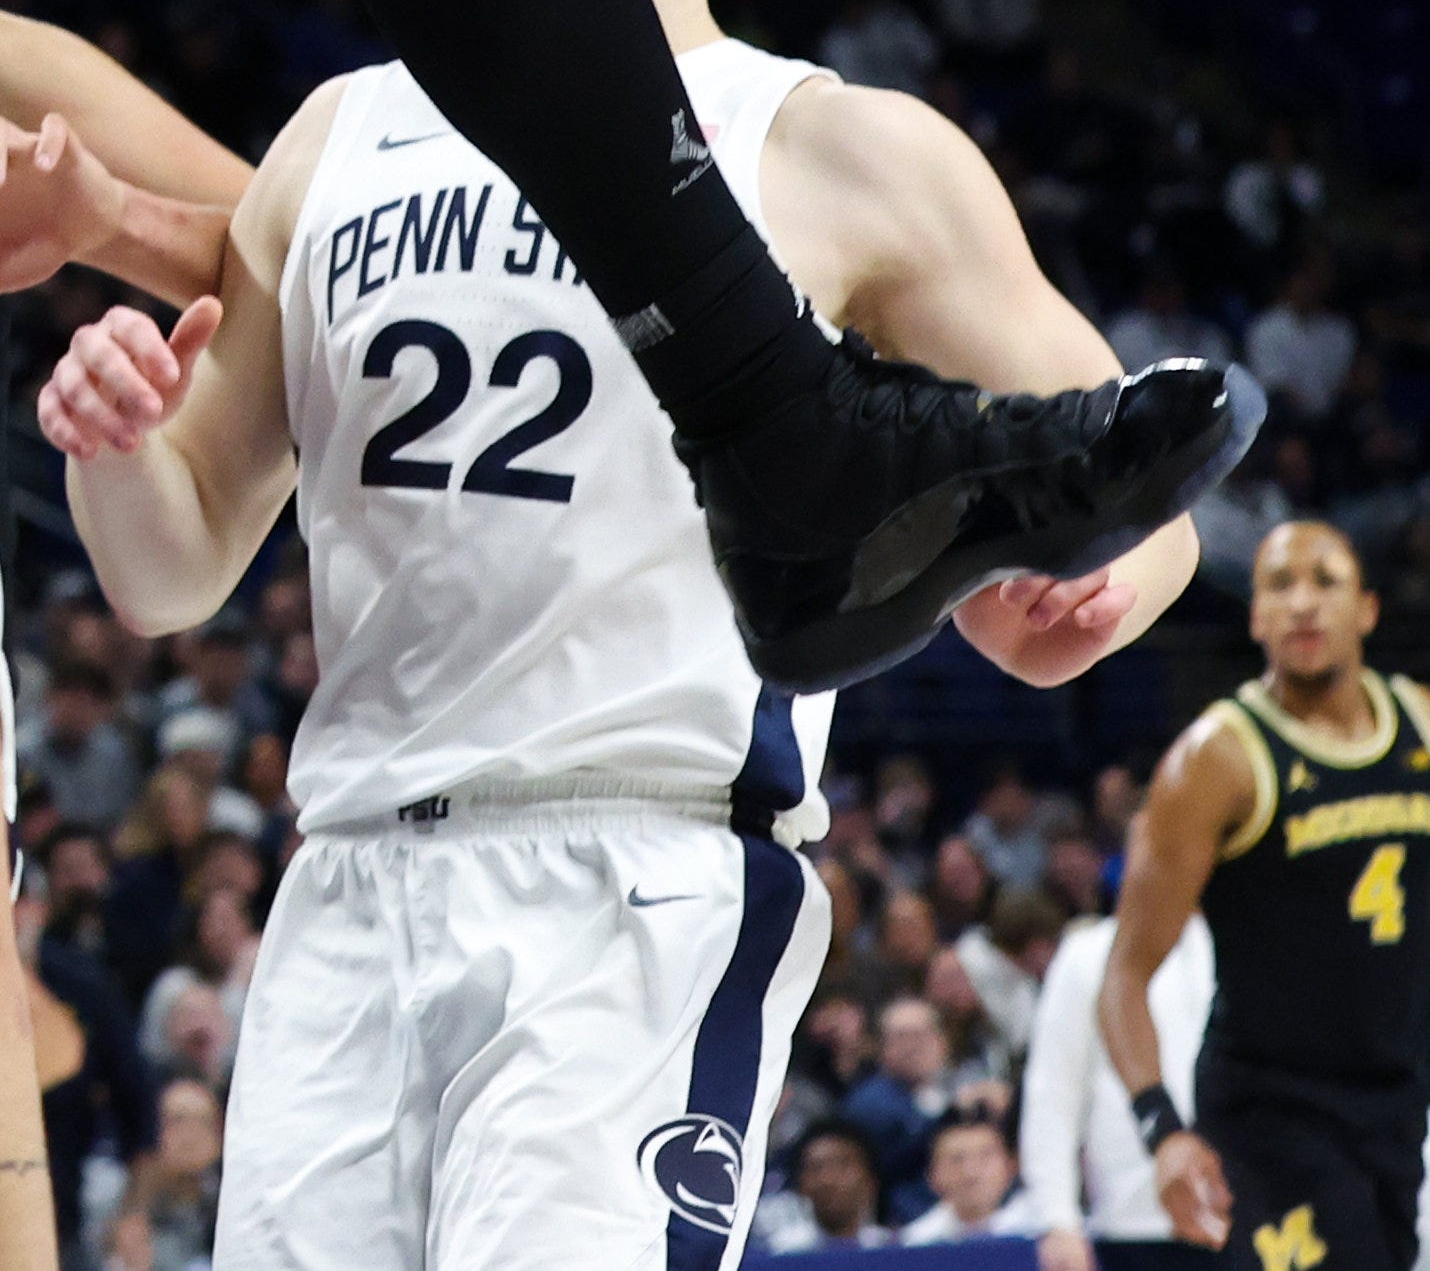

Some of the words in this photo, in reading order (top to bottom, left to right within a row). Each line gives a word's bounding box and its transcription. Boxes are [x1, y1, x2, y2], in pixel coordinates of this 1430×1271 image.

[327, 184, 494, 326] PENN
[361, 318, 594, 504] 22
[1349, 841, 1406, 945] 4
